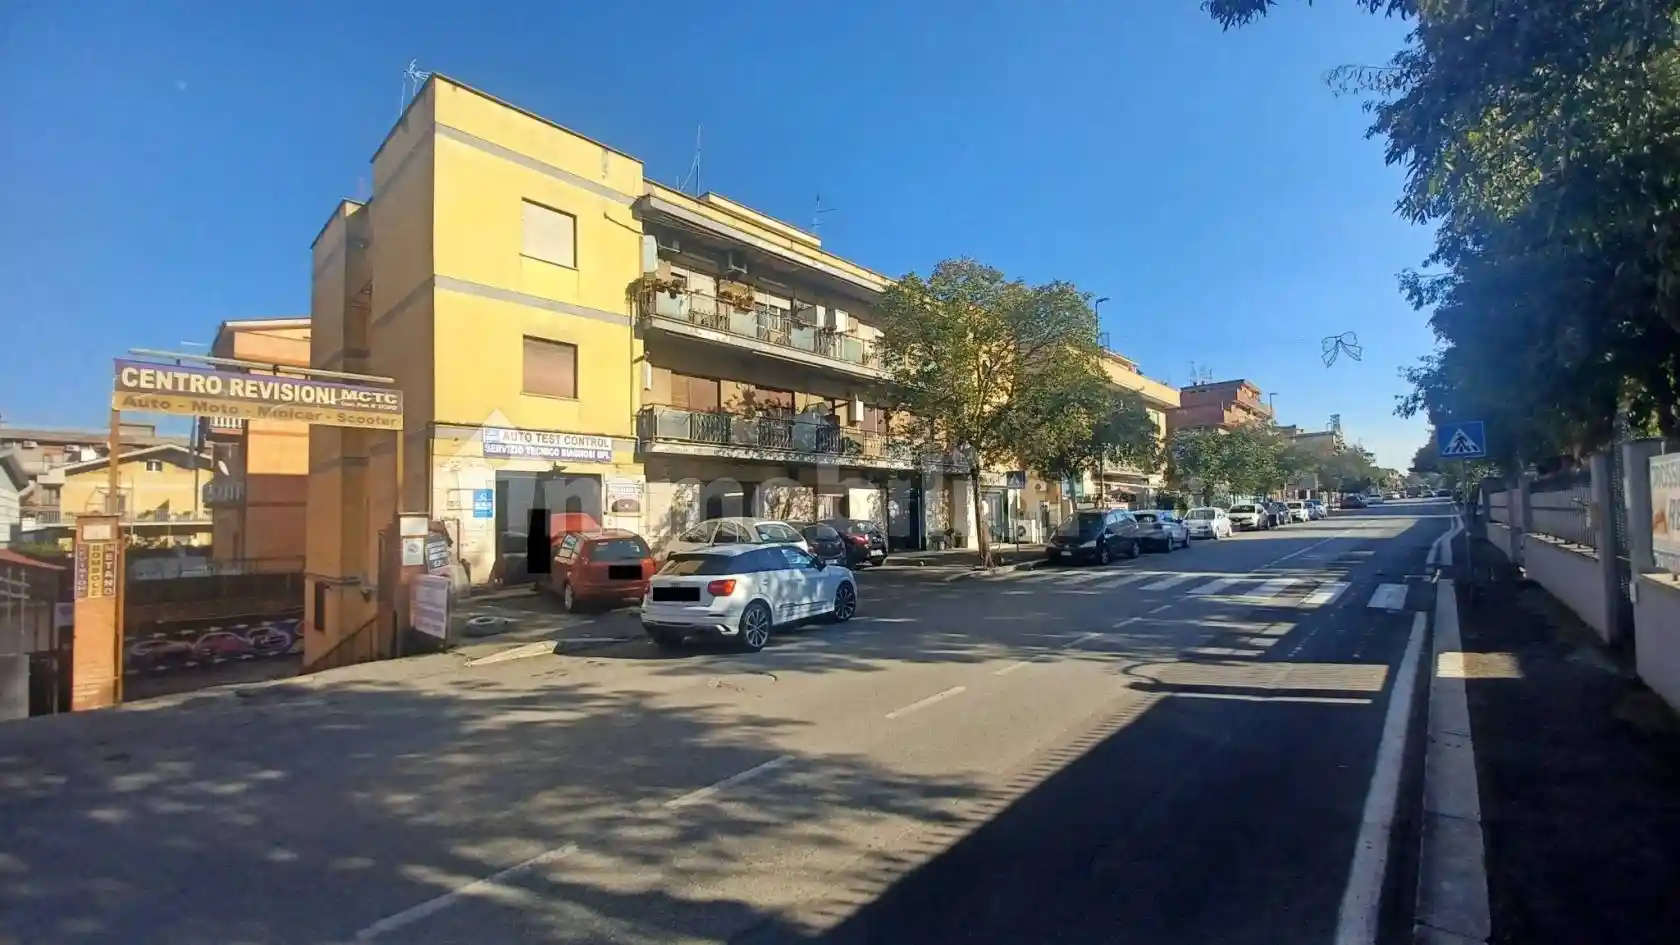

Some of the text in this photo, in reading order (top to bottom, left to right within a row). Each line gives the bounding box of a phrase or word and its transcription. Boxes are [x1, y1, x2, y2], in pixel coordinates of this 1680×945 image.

[121, 367, 398, 405] CENTRO REVISIONI MCTC
[122, 395, 172, 410] Auto
[191, 400, 240, 415] Moto
[257, 405, 324, 421] Minicar
[337, 412, 396, 427] Scooter
[484, 442, 524, 455] SERVIZIO
[525, 445, 560, 457] TECNICO
[502, 430, 533, 443] AUTO
[536, 433, 560, 445] TEST
[564, 436, 609, 448] CONTROL
[104, 543, 115, 596] METANO
